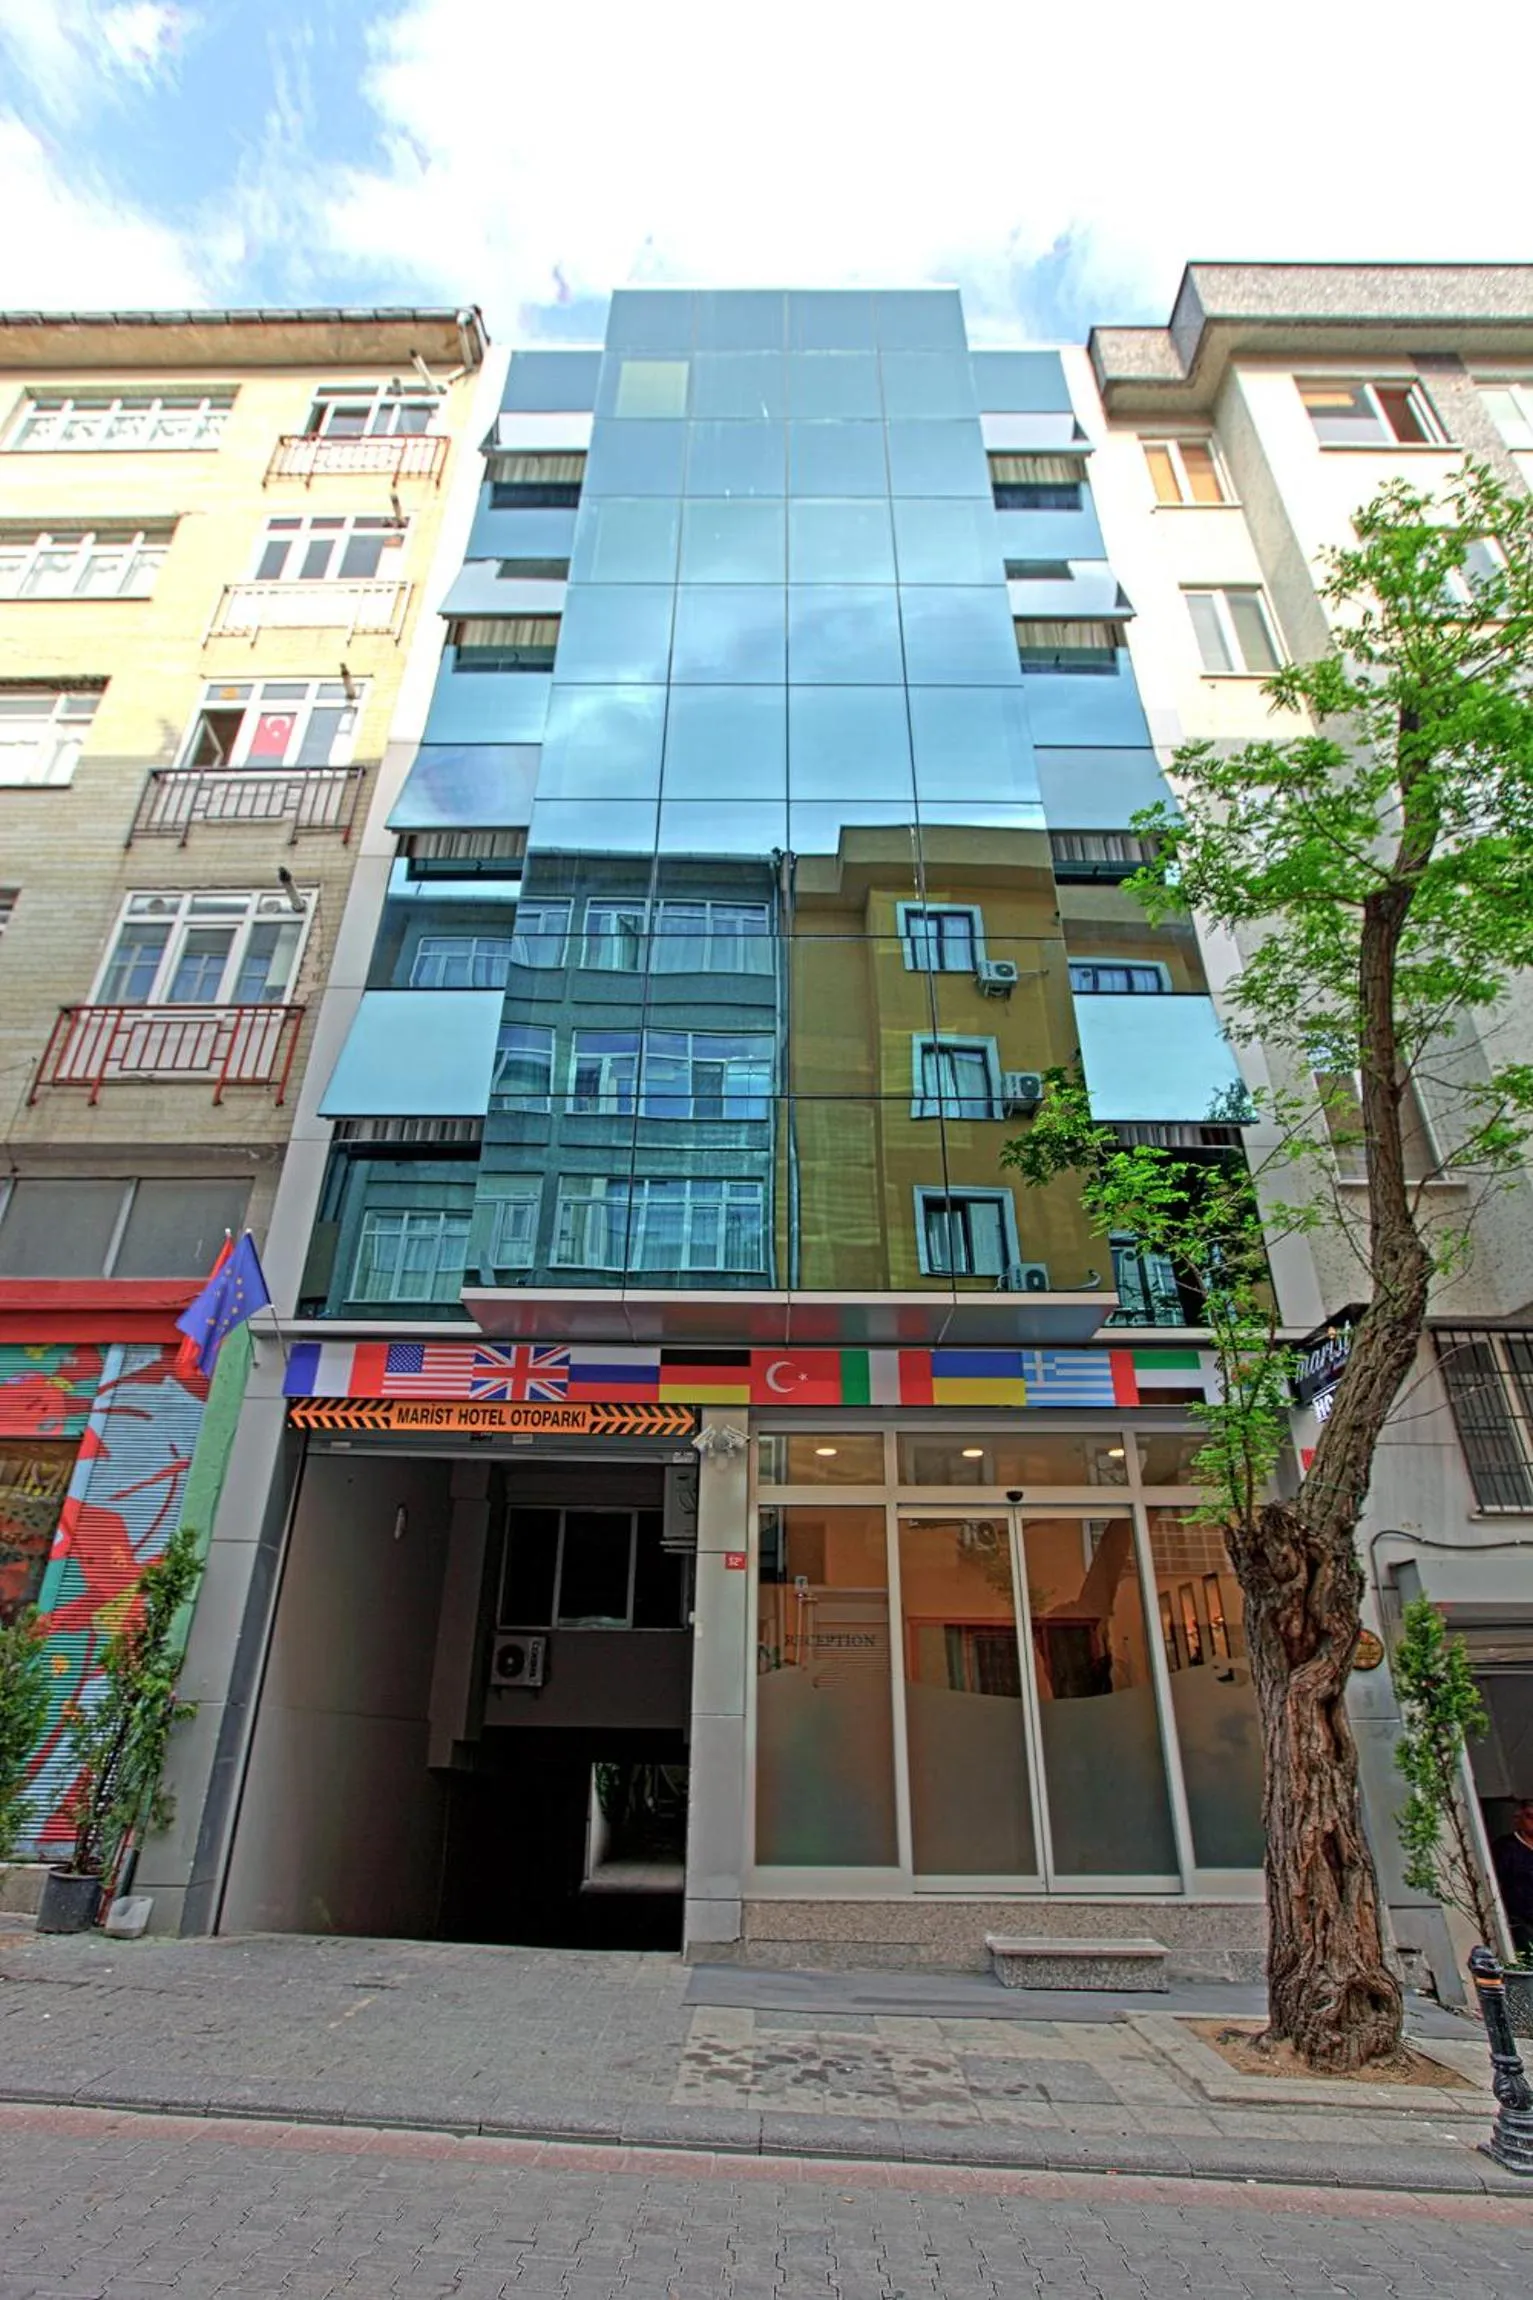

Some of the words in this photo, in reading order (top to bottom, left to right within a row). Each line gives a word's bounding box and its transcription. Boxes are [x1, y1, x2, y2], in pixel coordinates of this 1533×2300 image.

[396, 1403, 453, 1424] MARİST
[458, 1408, 507, 1426] HOTEL
[510, 1409, 586, 1427] OTOPARKI
[784, 1633, 876, 1647] RECEPTION
